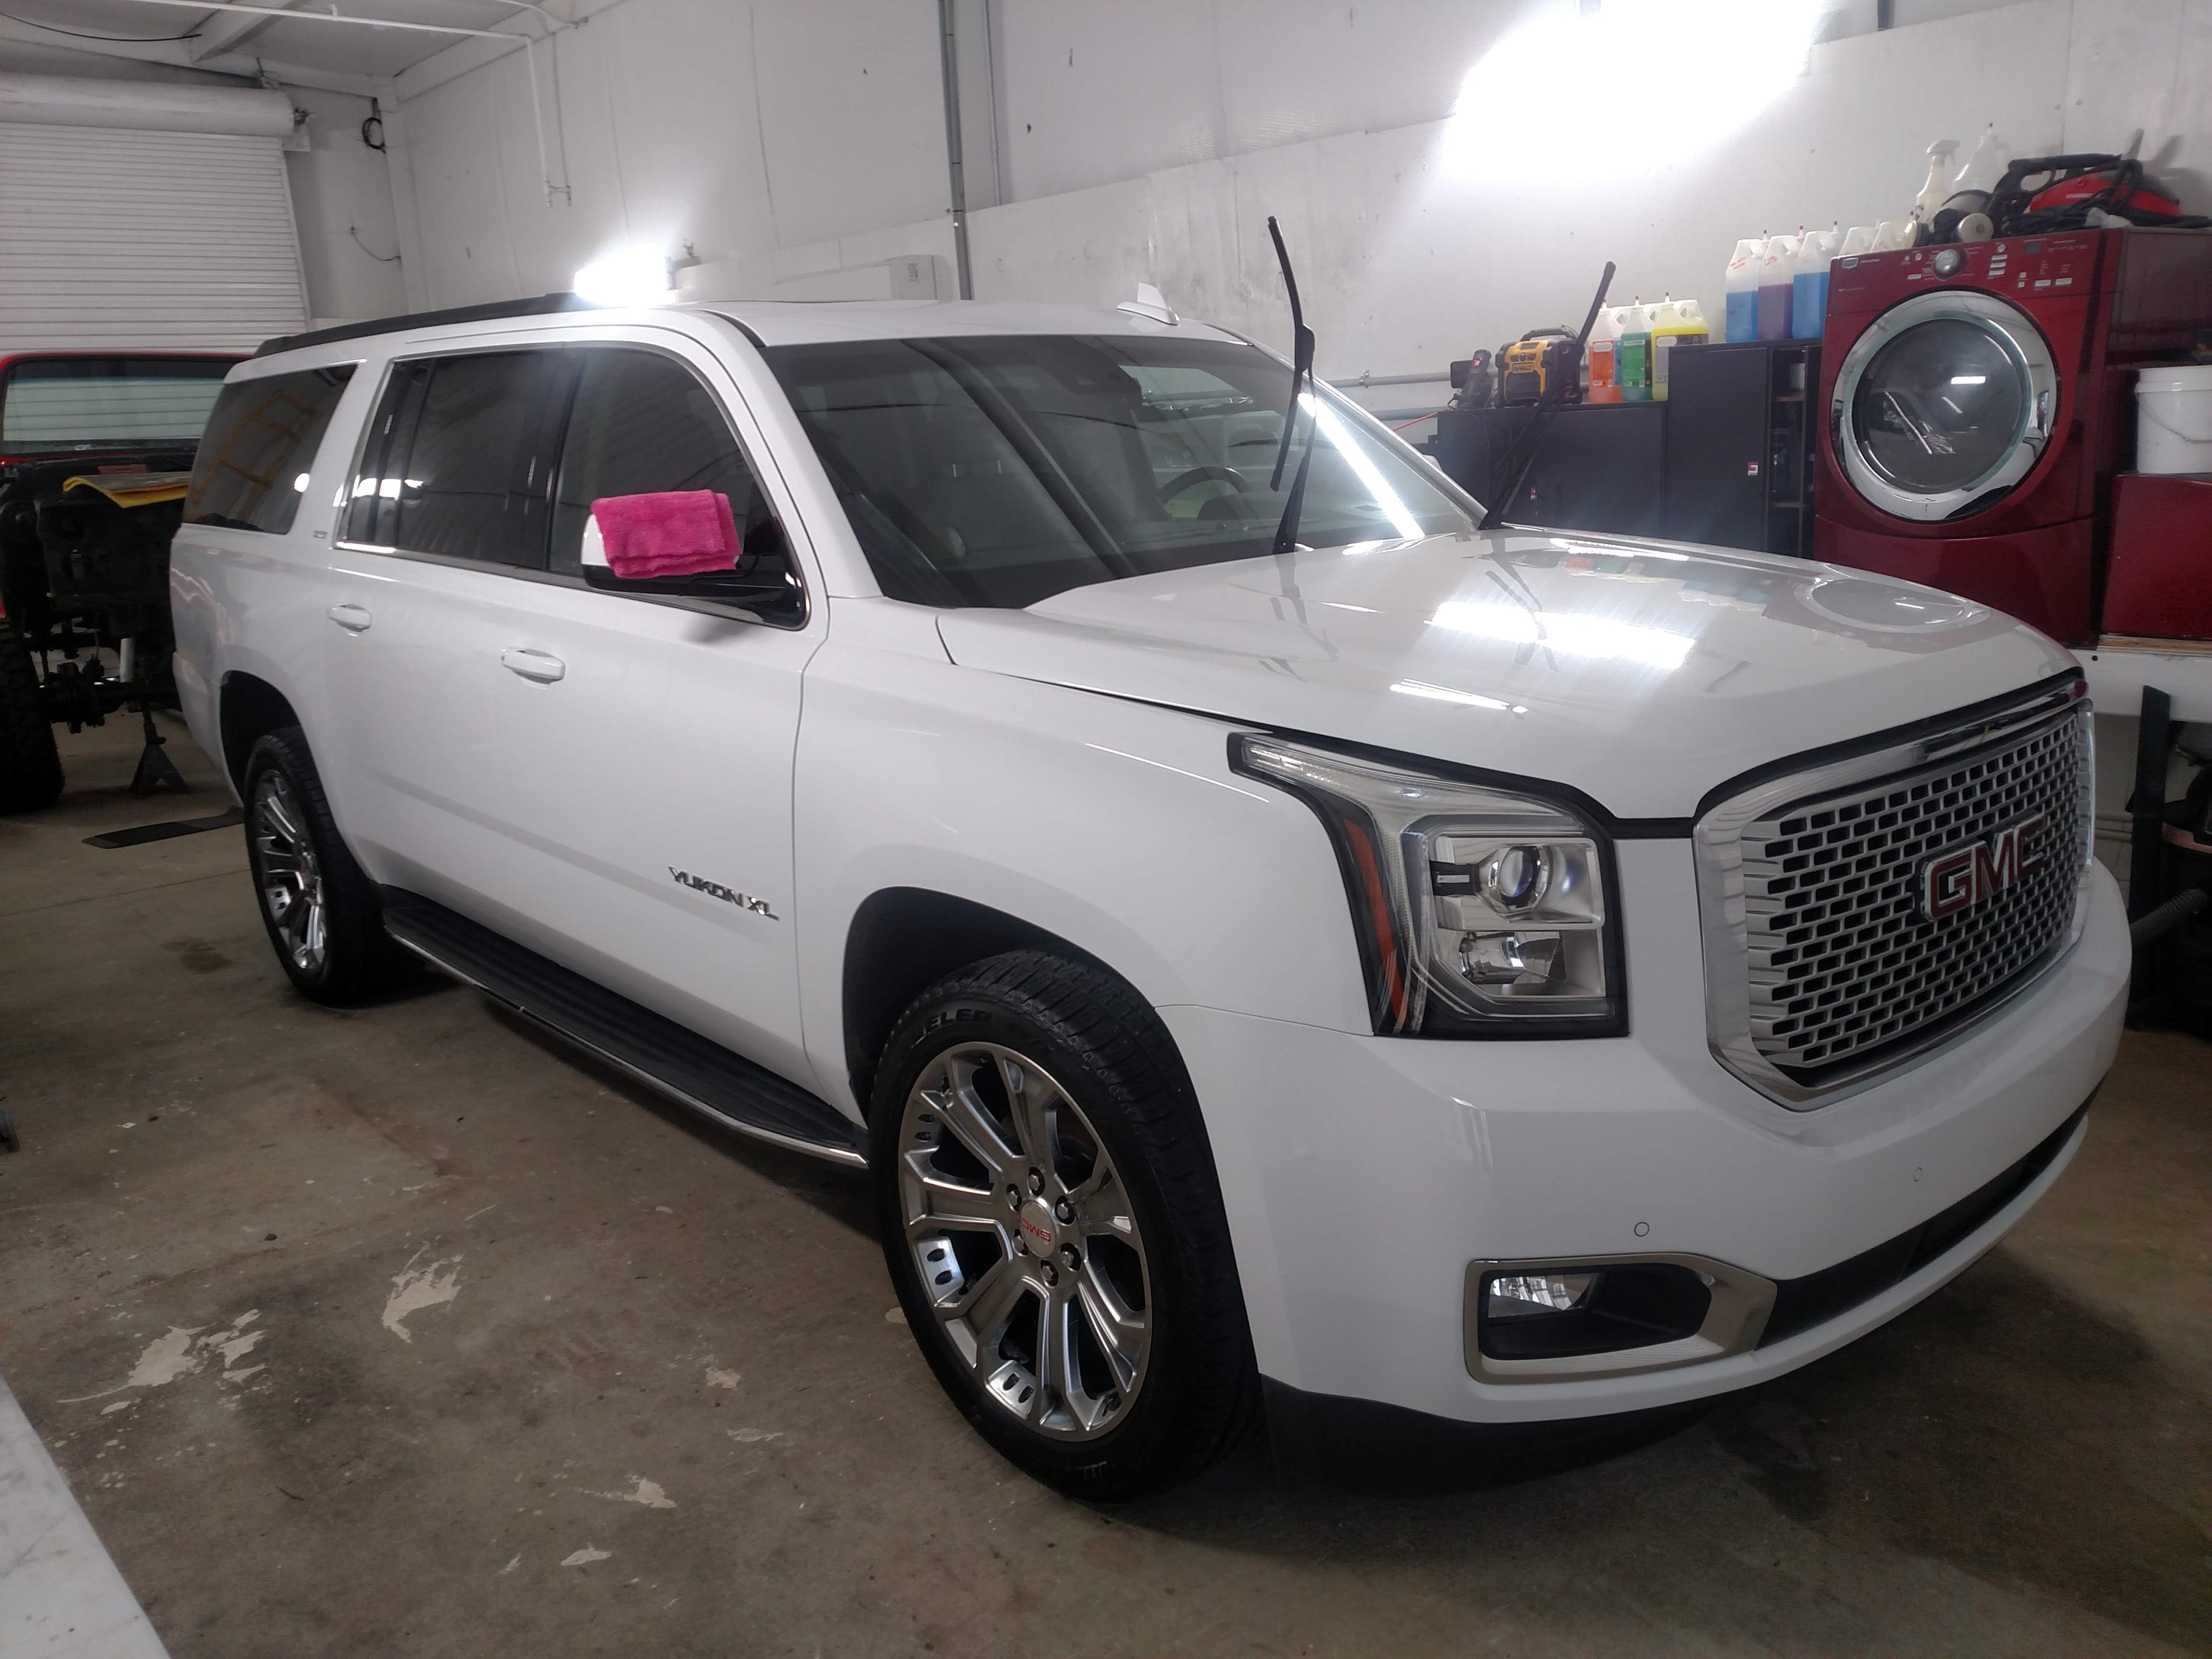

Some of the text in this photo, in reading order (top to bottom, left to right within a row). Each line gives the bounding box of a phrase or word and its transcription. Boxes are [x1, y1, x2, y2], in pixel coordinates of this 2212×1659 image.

[668, 865, 779, 922] YUKON XL
[1925, 811, 2045, 922] GMC
[1021, 1218, 1051, 1242] GMC
